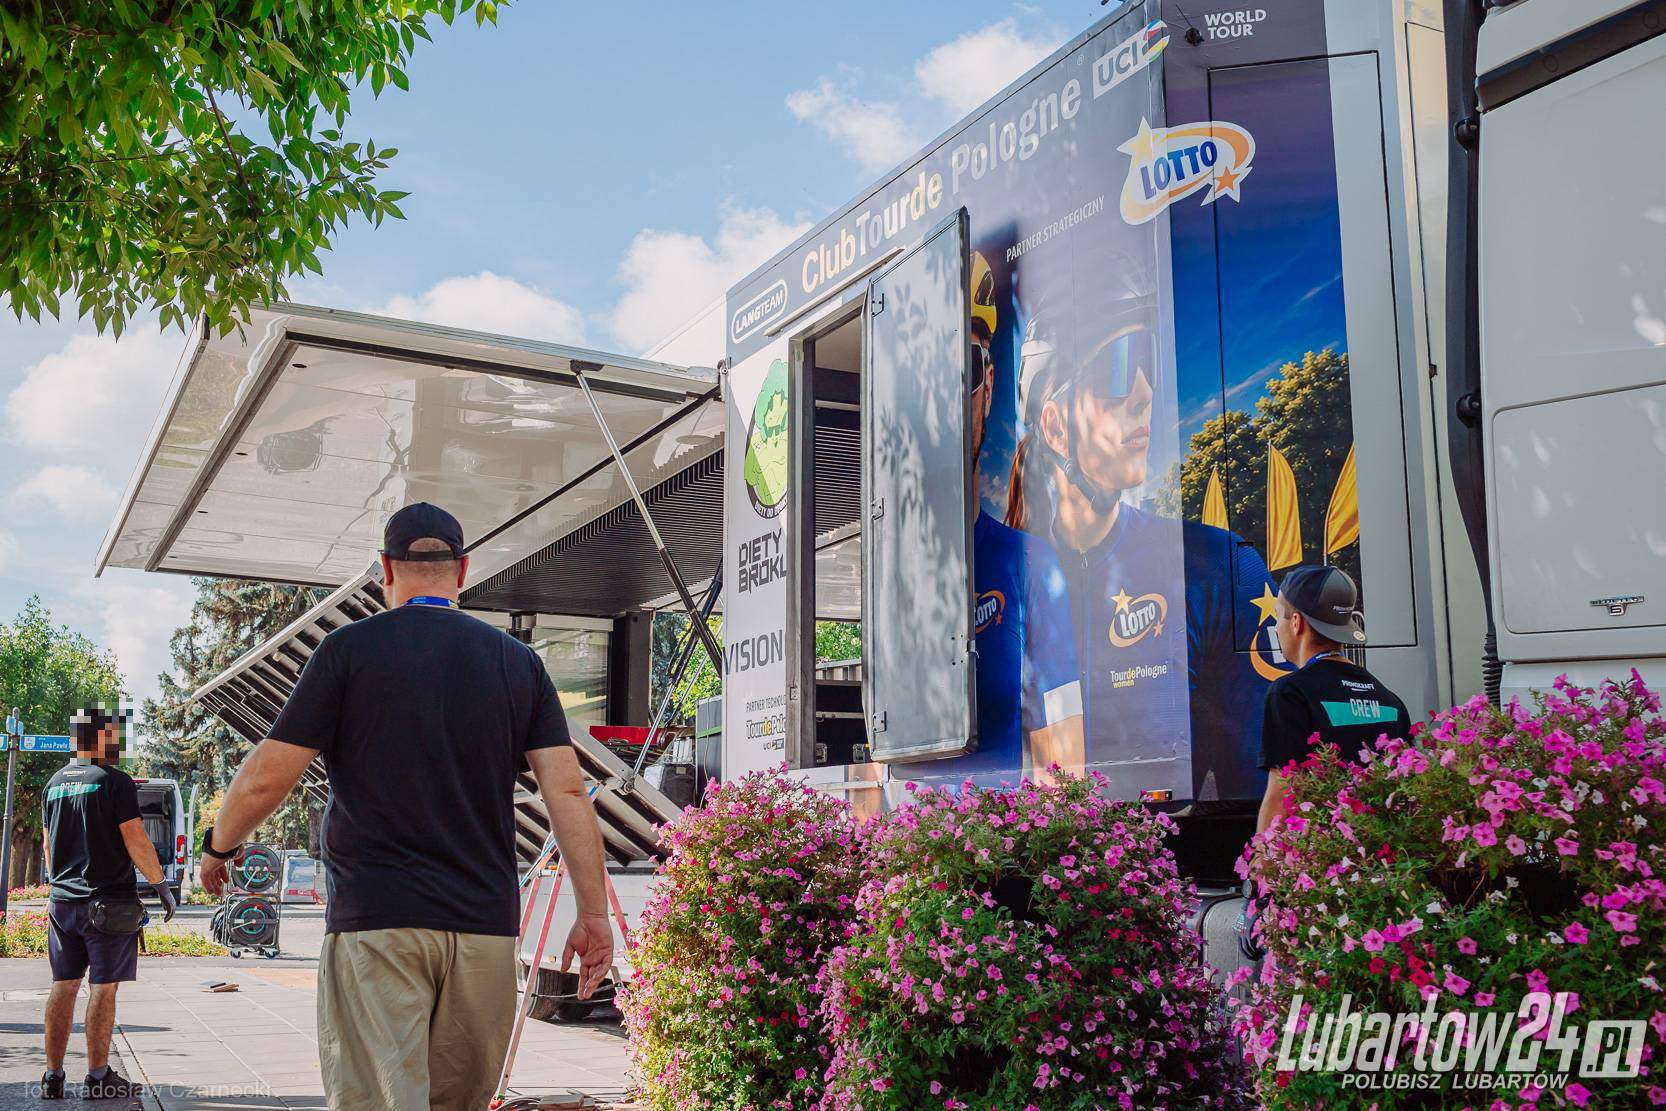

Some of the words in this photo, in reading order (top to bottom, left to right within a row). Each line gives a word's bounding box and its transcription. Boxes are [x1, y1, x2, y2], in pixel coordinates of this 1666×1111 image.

[1205, 9, 1267, 26] WORLD
[1208, 23, 1253, 40] TOUR
[1097, 47, 1139, 86] UCI
[952, 78, 1081, 195] Pologne
[1140, 140, 1218, 200] LOTTO
[1006, 231, 1043, 263] PARTNER
[1043, 194, 1105, 242] STRATEGICZNY
[735, 290, 783, 334] LANGTEAM
[738, 527, 782, 568] DIETY
[1120, 602, 1156, 637] LOTTO
[722, 629, 787, 675] VISION
[1350, 698, 1381, 718] CREW
